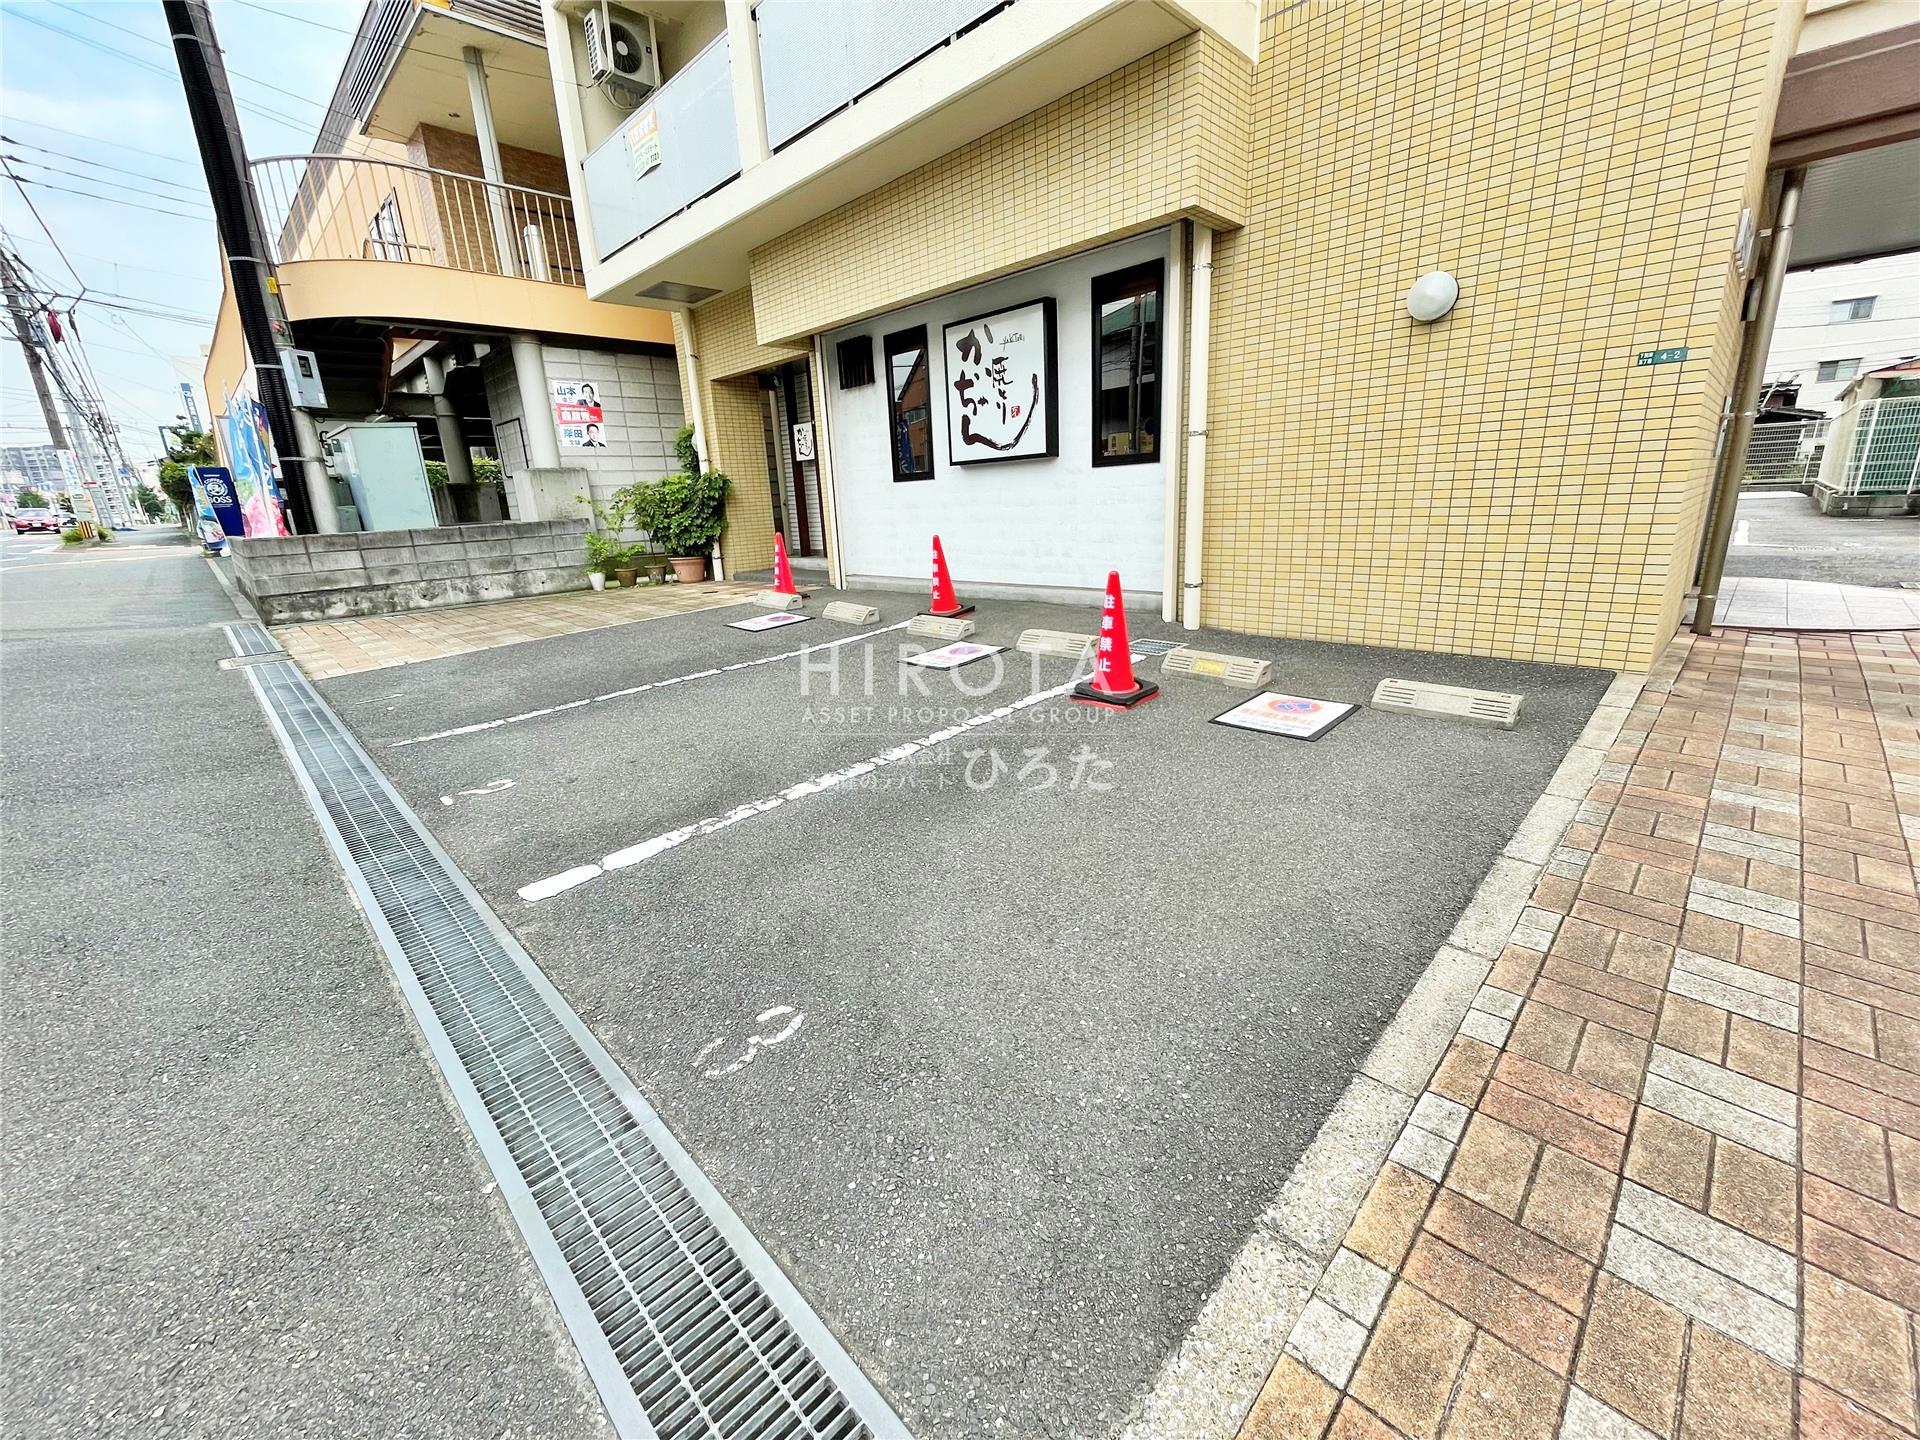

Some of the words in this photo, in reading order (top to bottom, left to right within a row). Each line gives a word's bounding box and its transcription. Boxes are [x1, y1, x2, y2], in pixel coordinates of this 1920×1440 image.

[556, 386, 576, 396] 山本
[1099, 594, 1115, 673] 駐車禁止
